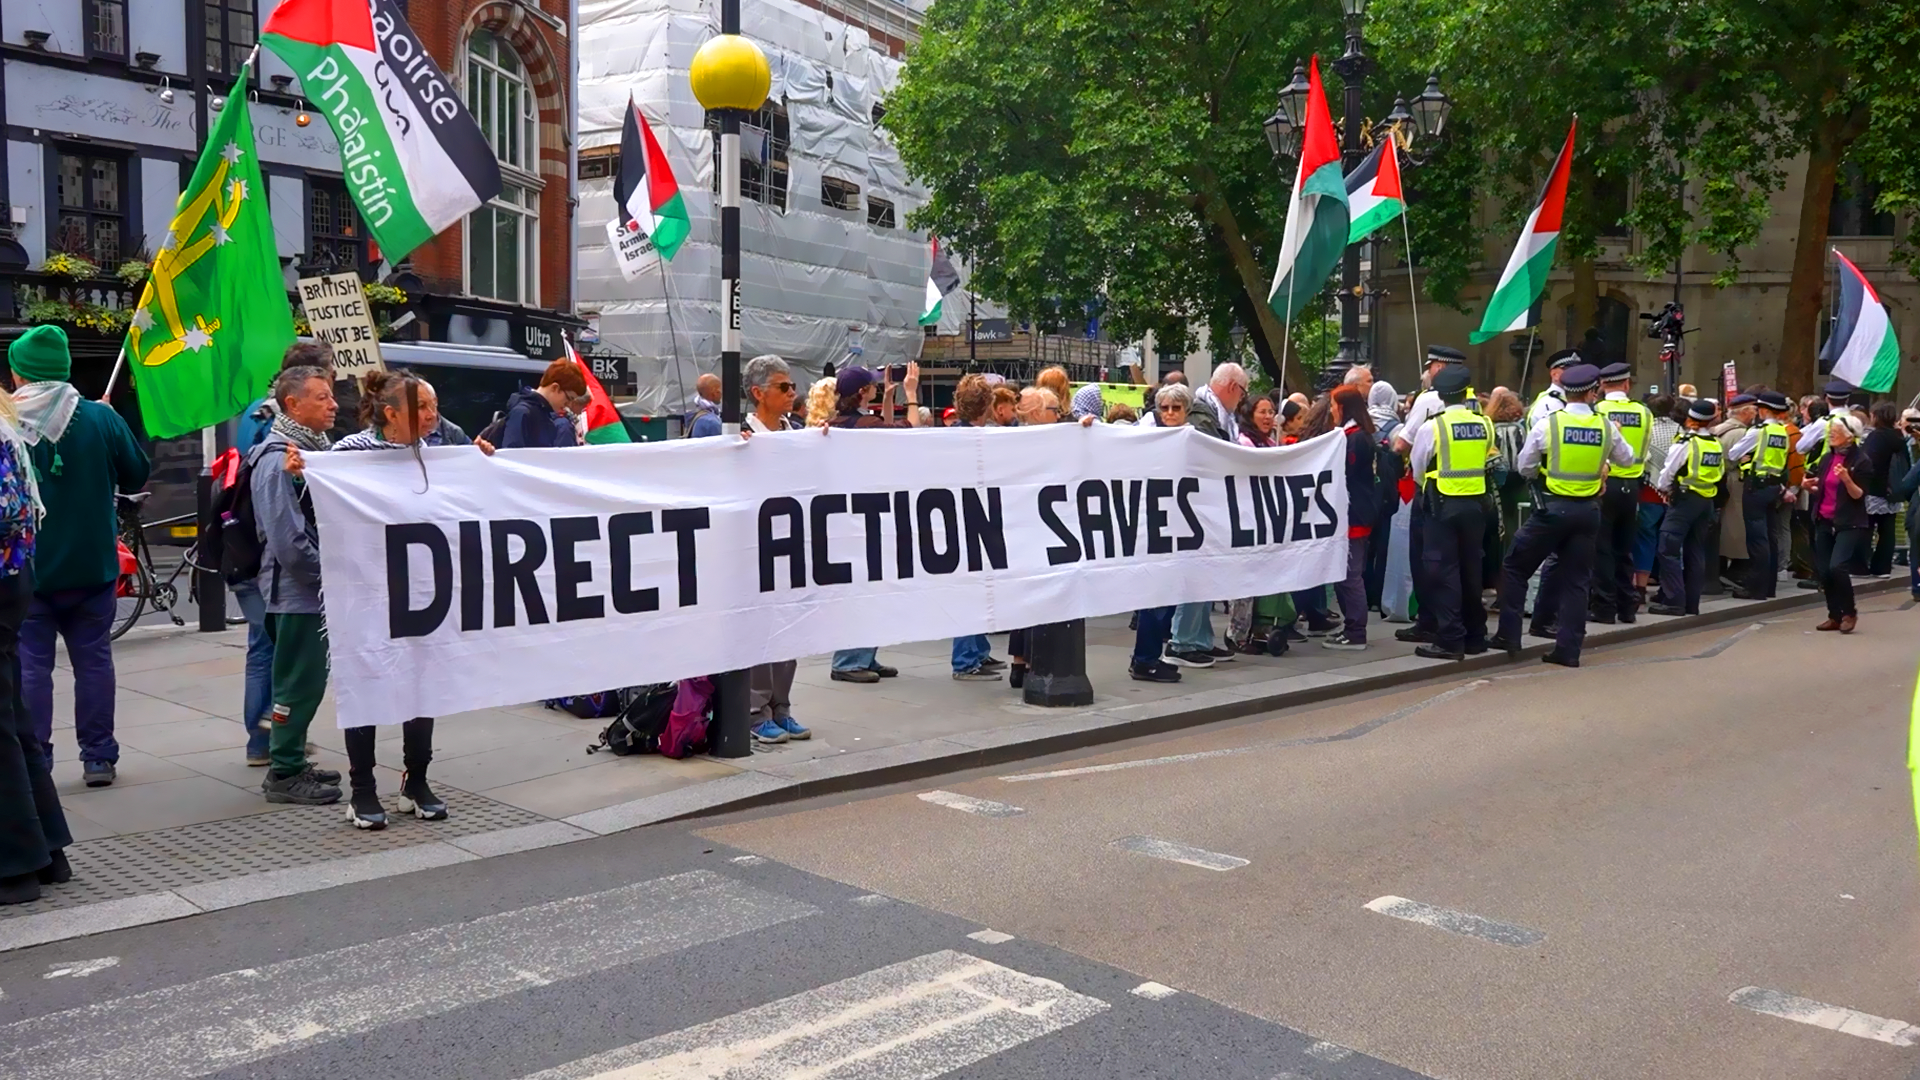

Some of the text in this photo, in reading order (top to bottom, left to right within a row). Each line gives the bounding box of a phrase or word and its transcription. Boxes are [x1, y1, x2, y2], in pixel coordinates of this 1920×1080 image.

[142, 103, 181, 130] The
[619, 232, 649, 251] Armin
[303, 279, 358, 300] BRITISH
[308, 300, 364, 322] JUSTICE
[316, 325, 371, 344] MUST BE
[525, 325, 551, 347] Ultra
[592, 359, 618, 373] BK
[592, 372, 619, 380] NEWS
[1609, 414, 1640, 425] POLICE
[1453, 425, 1486, 438] POLICE
[1565, 429, 1602, 444] POLICE
[384, 469, 1339, 640] DIRECT ACTION SAVES LIVES
